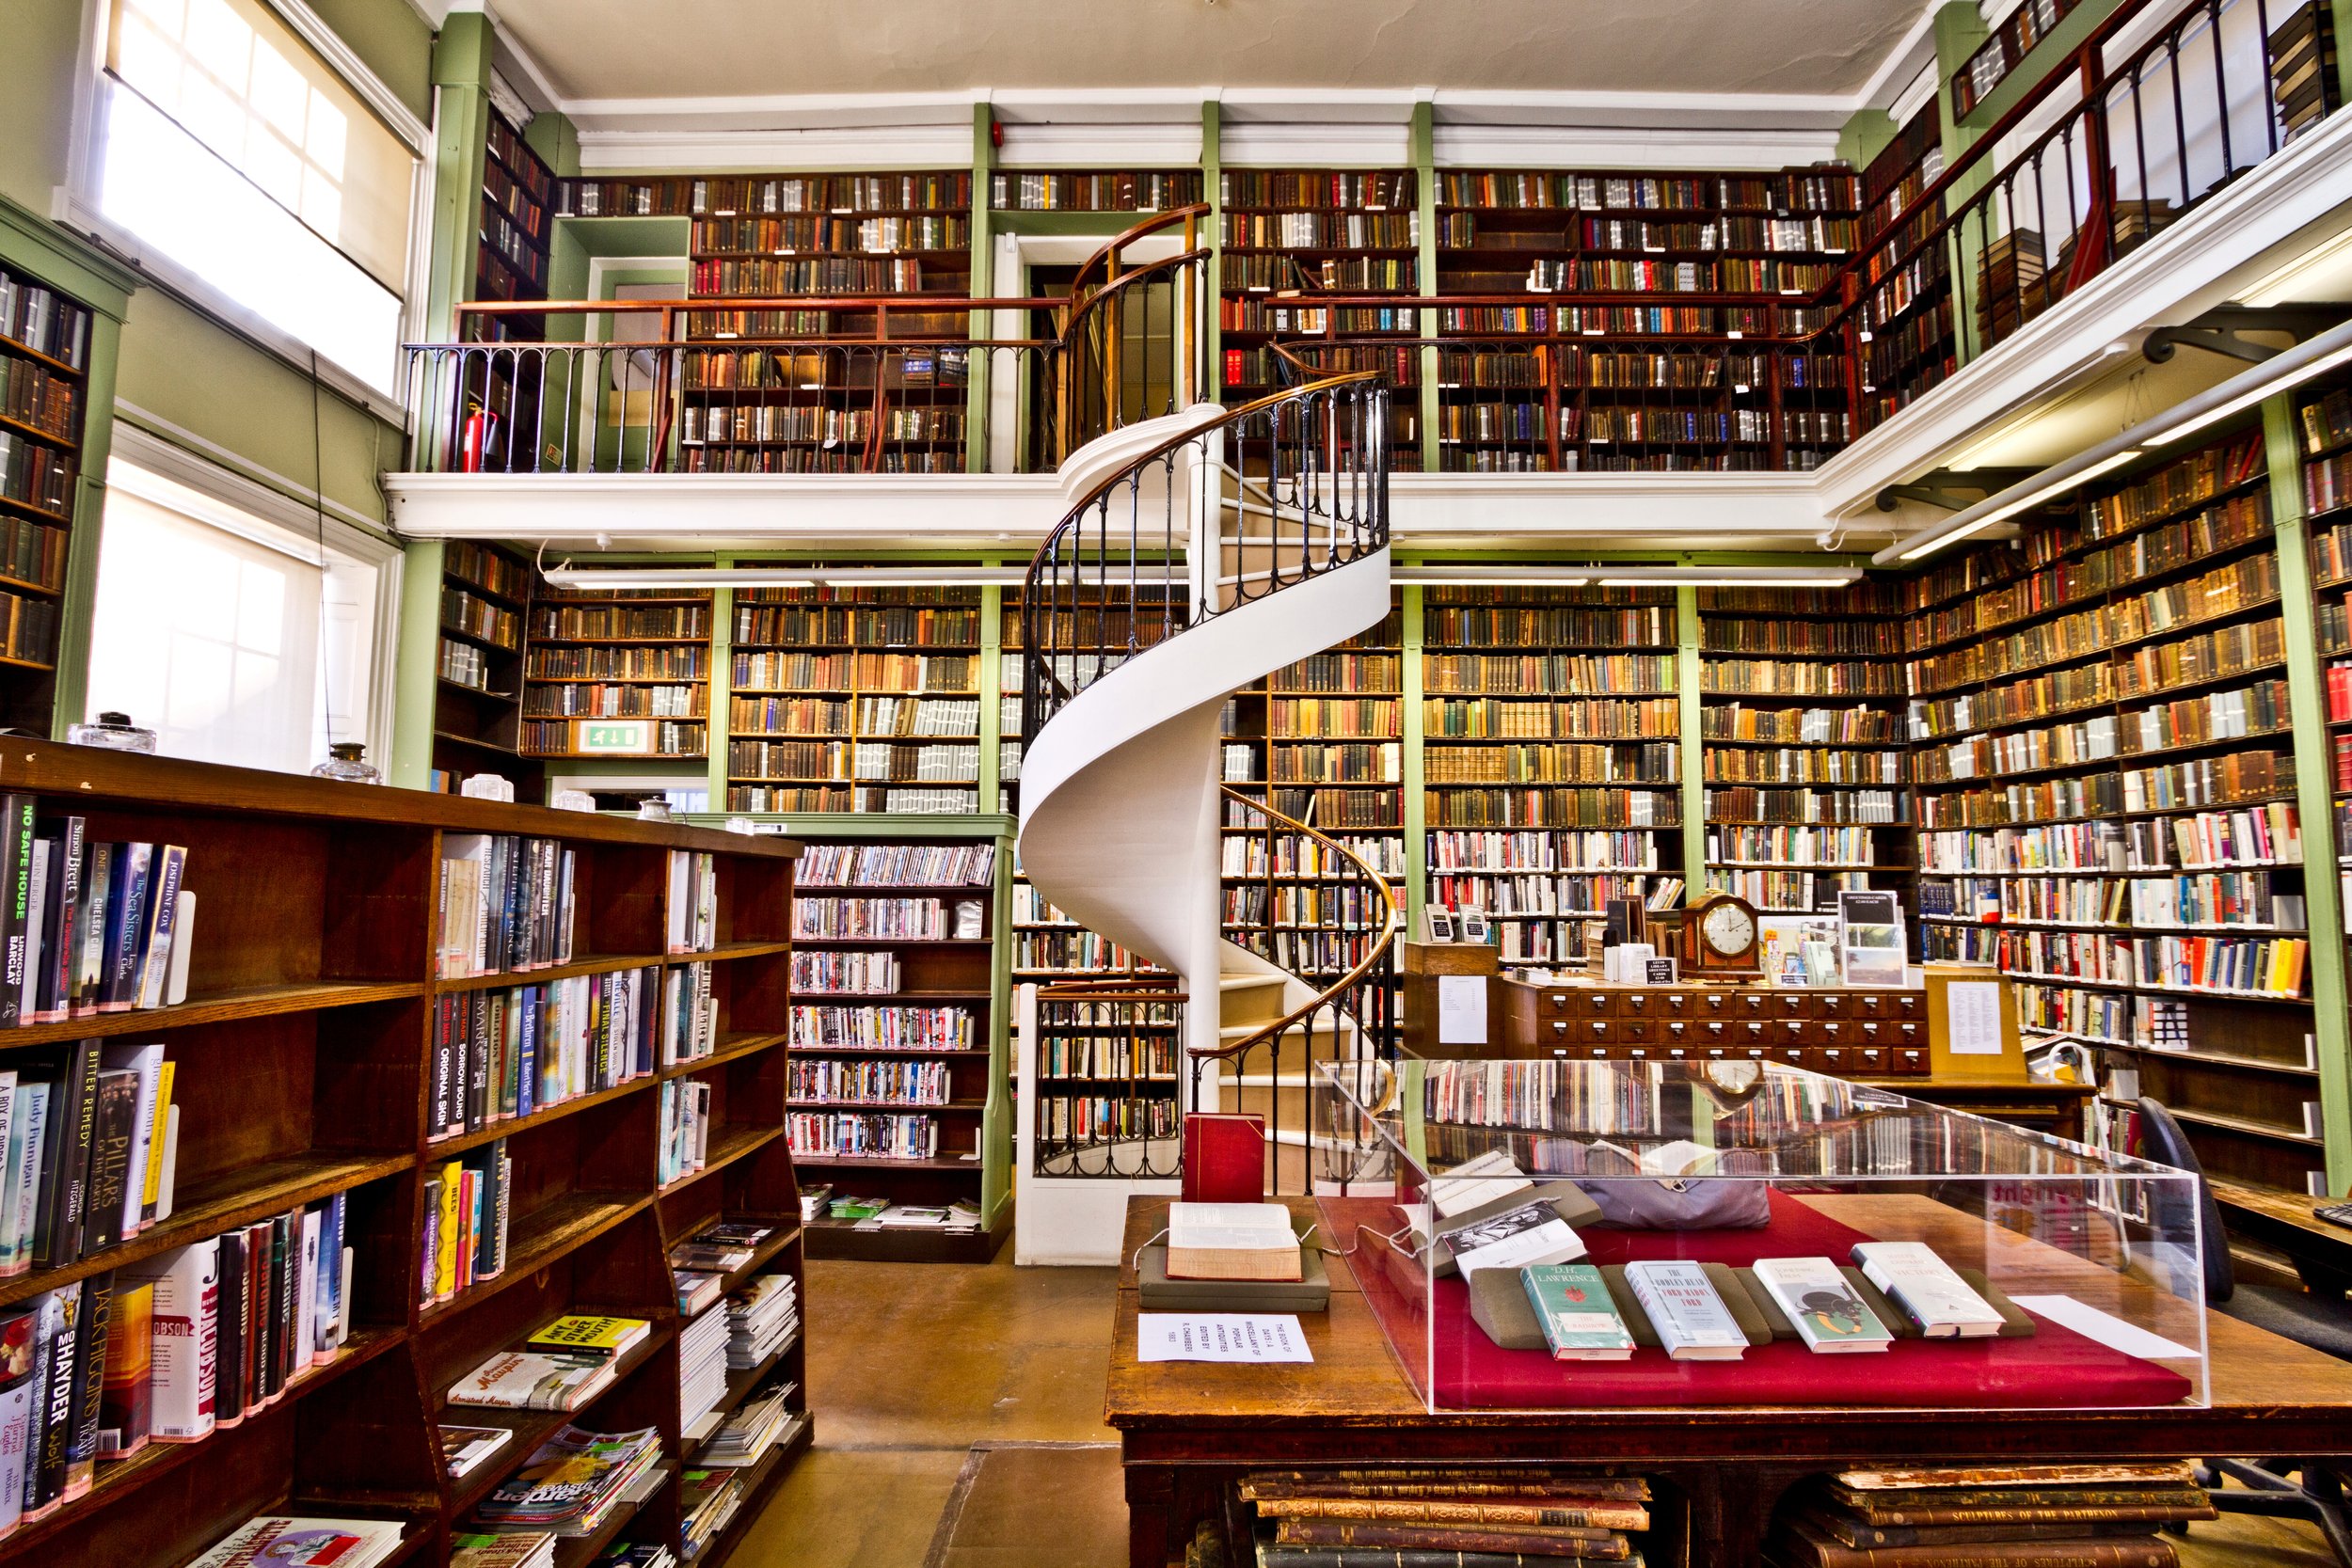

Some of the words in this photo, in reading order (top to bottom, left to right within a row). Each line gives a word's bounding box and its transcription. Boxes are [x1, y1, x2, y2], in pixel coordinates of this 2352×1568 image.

[23, 805, 33, 826] NO
[20, 831, 30, 866] SAFE
[72, 825, 82, 855] Simon
[34, 855, 42, 877] JOHN
[98, 850, 107, 869] ONE
[483, 847, 492, 890] RESEARCH
[545, 845, 553, 867] DEAR
[68, 857, 81, 891] Brett
[136, 878, 145, 891] The
[164, 861, 179, 908] JOSEPHINE
[510, 850, 518, 909] STEPHEN
[17, 871, 27, 919] HOUSE
[31, 879, 40, 911] BERGER
[129, 891, 142, 911] Sea
[541, 870, 552, 915] DAUGHTER
[91, 898, 103, 935] CHELSEA
[123, 913, 139, 951] Sisters
[161, 910, 170, 927] COX
[8, 936, 17, 985] BARCLAY
[16, 936, 24, 985] LINWOOD
[90, 938, 99, 958] CAIN
[119, 958, 128, 980] Clarke
[443, 998, 452, 1022] DAVID
[601, 1005, 610, 1032] FINAL
[441, 1022, 450, 1044] MARK
[523, 1015, 534, 1047] Brethren
[457, 1043, 466, 1085] SORROW
[599, 1034, 609, 1073] SILENCE
[85, 1051, 98, 1091] BITTER
[438, 1048, 450, 1099] ORIGINAL
[523, 1062, 532, 1080] Robert
[29, 1093, 43, 1124] Judy
[437, 1101, 448, 1126] SKIN
[455, 1085, 464, 1119] BOUND
[79, 1099, 93, 1148] REMEDY
[23, 1127, 40, 1188] Finnigan
[68, 1180, 79, 1222] FITZGERALD
[427, 1214, 436, 1265] HANGMAN'S
[258, 1262, 270, 1328] Jardine
[282, 1260, 292, 1323] Jardine
[425, 1268, 434, 1293] SONG
[93, 1288, 112, 1336] JACK
[57, 1330, 75, 1346] MO
[562, 1321, 596, 1341] OTHER
[577, 1318, 617, 1343] MOUTH
[1183, 1327, 1193, 1353] CHAMBERS
[1200, 1325, 1209, 1342] EDITED
[1216, 1324, 1229, 1353] ANTIQUITIES
[1232, 1327, 1244, 1349] POPULAR
[1246, 1322, 1258, 1349] MISCELLANY
[1279, 1334, 1288, 1347] BOOK
[199, 1308, 217, 1403] JACOBSON
[260, 1331, 269, 1369] BLOOD
[50, 1346, 74, 1425] HAYDER
[84, 1339, 107, 1418] HIGGINS
[258, 1370, 267, 1394] RED
[477, 1359, 525, 1390] Maupin
[451, 1394, 485, 1404] Armistead
[485, 1396, 512, 1406] Maupin
[2, 1425, 12, 1455] Eagles
[18, 1414, 27, 1452] Cynthia
[76, 1422, 90, 1461] TRADE
[4, 1468, 13, 1505] PHOENIX
[1951, 1510, 2013, 1521] SCULPTURES
[2019, 1510, 2032, 1519] OF
[2037, 1510, 2056, 1519] THE
[2063, 1509, 2118, 1520] PARTHENON
[1926, 1558, 1982, 1568] PARTHENON
[1989, 1558, 2007, 1567] THE
[2014, 1559, 2026, 1567] OF
[2034, 1558, 2097, 1567] SCULPTURES
